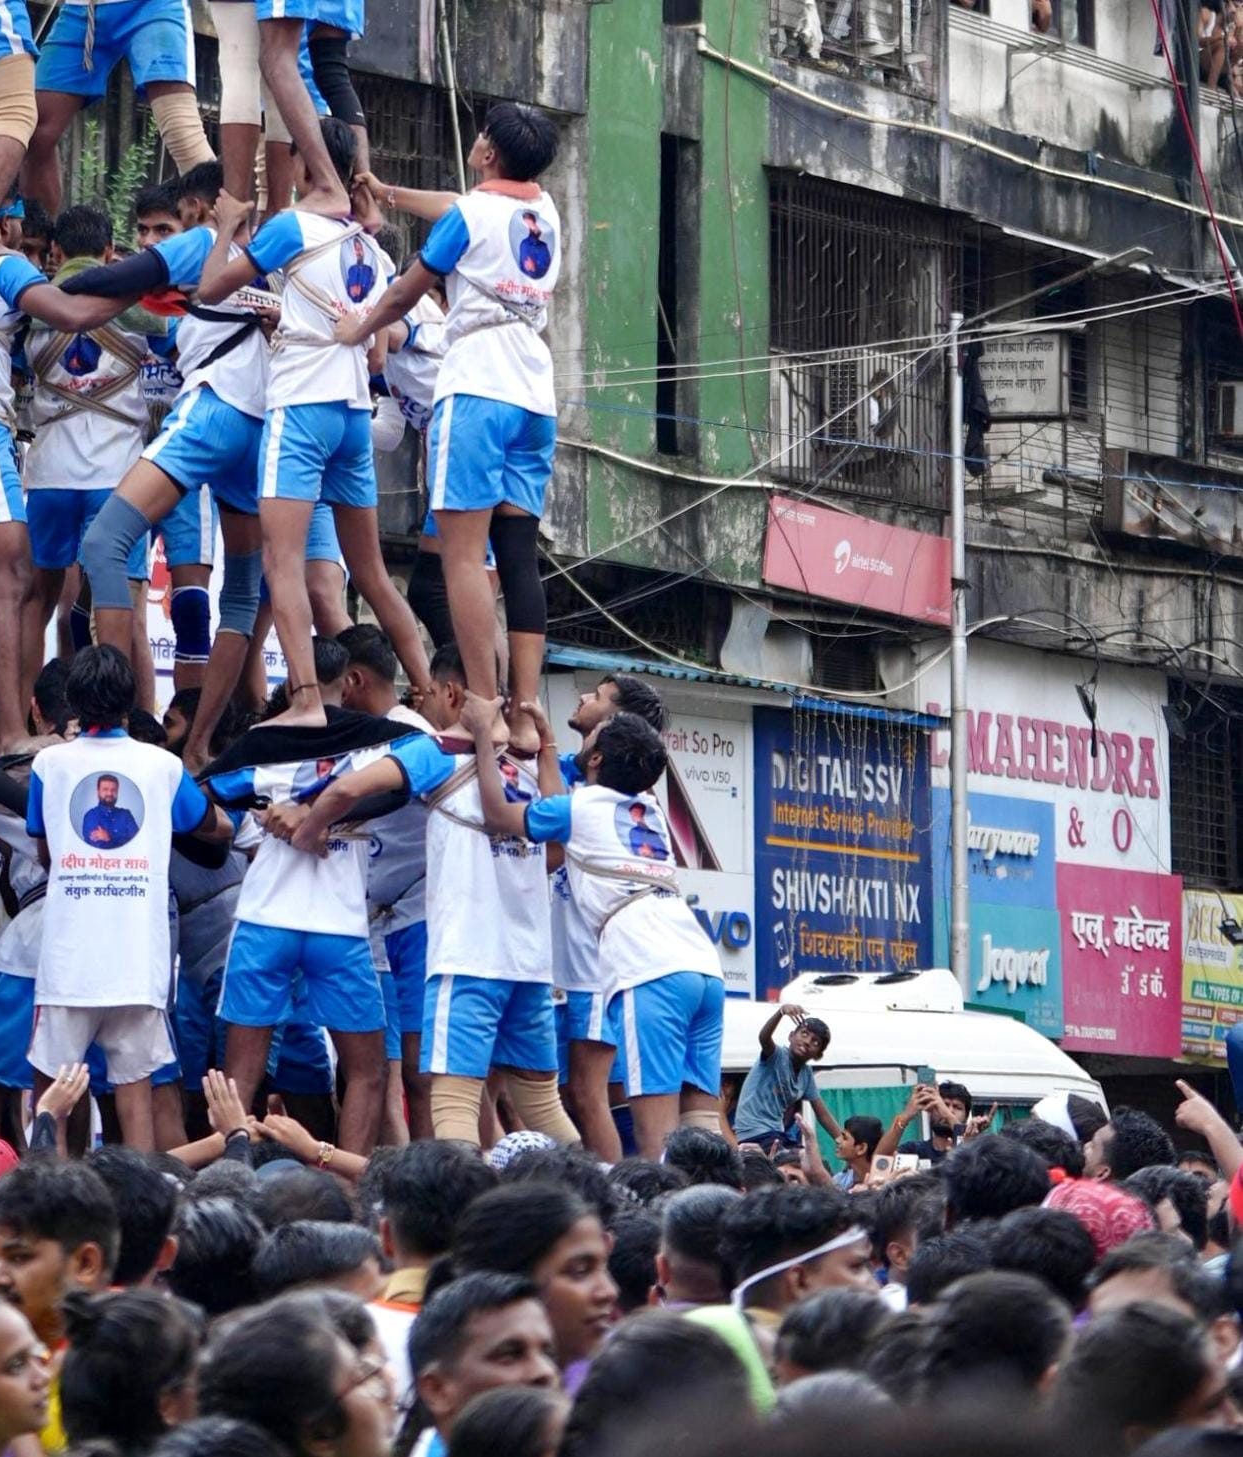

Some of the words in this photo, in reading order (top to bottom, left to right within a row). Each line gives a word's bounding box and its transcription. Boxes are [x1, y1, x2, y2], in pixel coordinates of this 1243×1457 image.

[852, 553, 869, 571] airtel
[692, 730, 709, 755] So
[713, 732, 735, 758] Pro
[967, 708, 1160, 800] MAHENDRA
[772, 751, 857, 799] DIGITAL
[861, 763, 903, 806] SSV
[773, 800, 821, 830] Internet
[823, 804, 865, 836] Service
[867, 810, 914, 840] Provider
[1068, 806, 1087, 848] &
[89, 853, 121, 870] मोहन
[772, 867, 890, 921] SHIVSHAKTI
[894, 882, 921, 925] NX
[976, 933, 1050, 994] Jaquar
[1193, 983, 1208, 999] ALL
